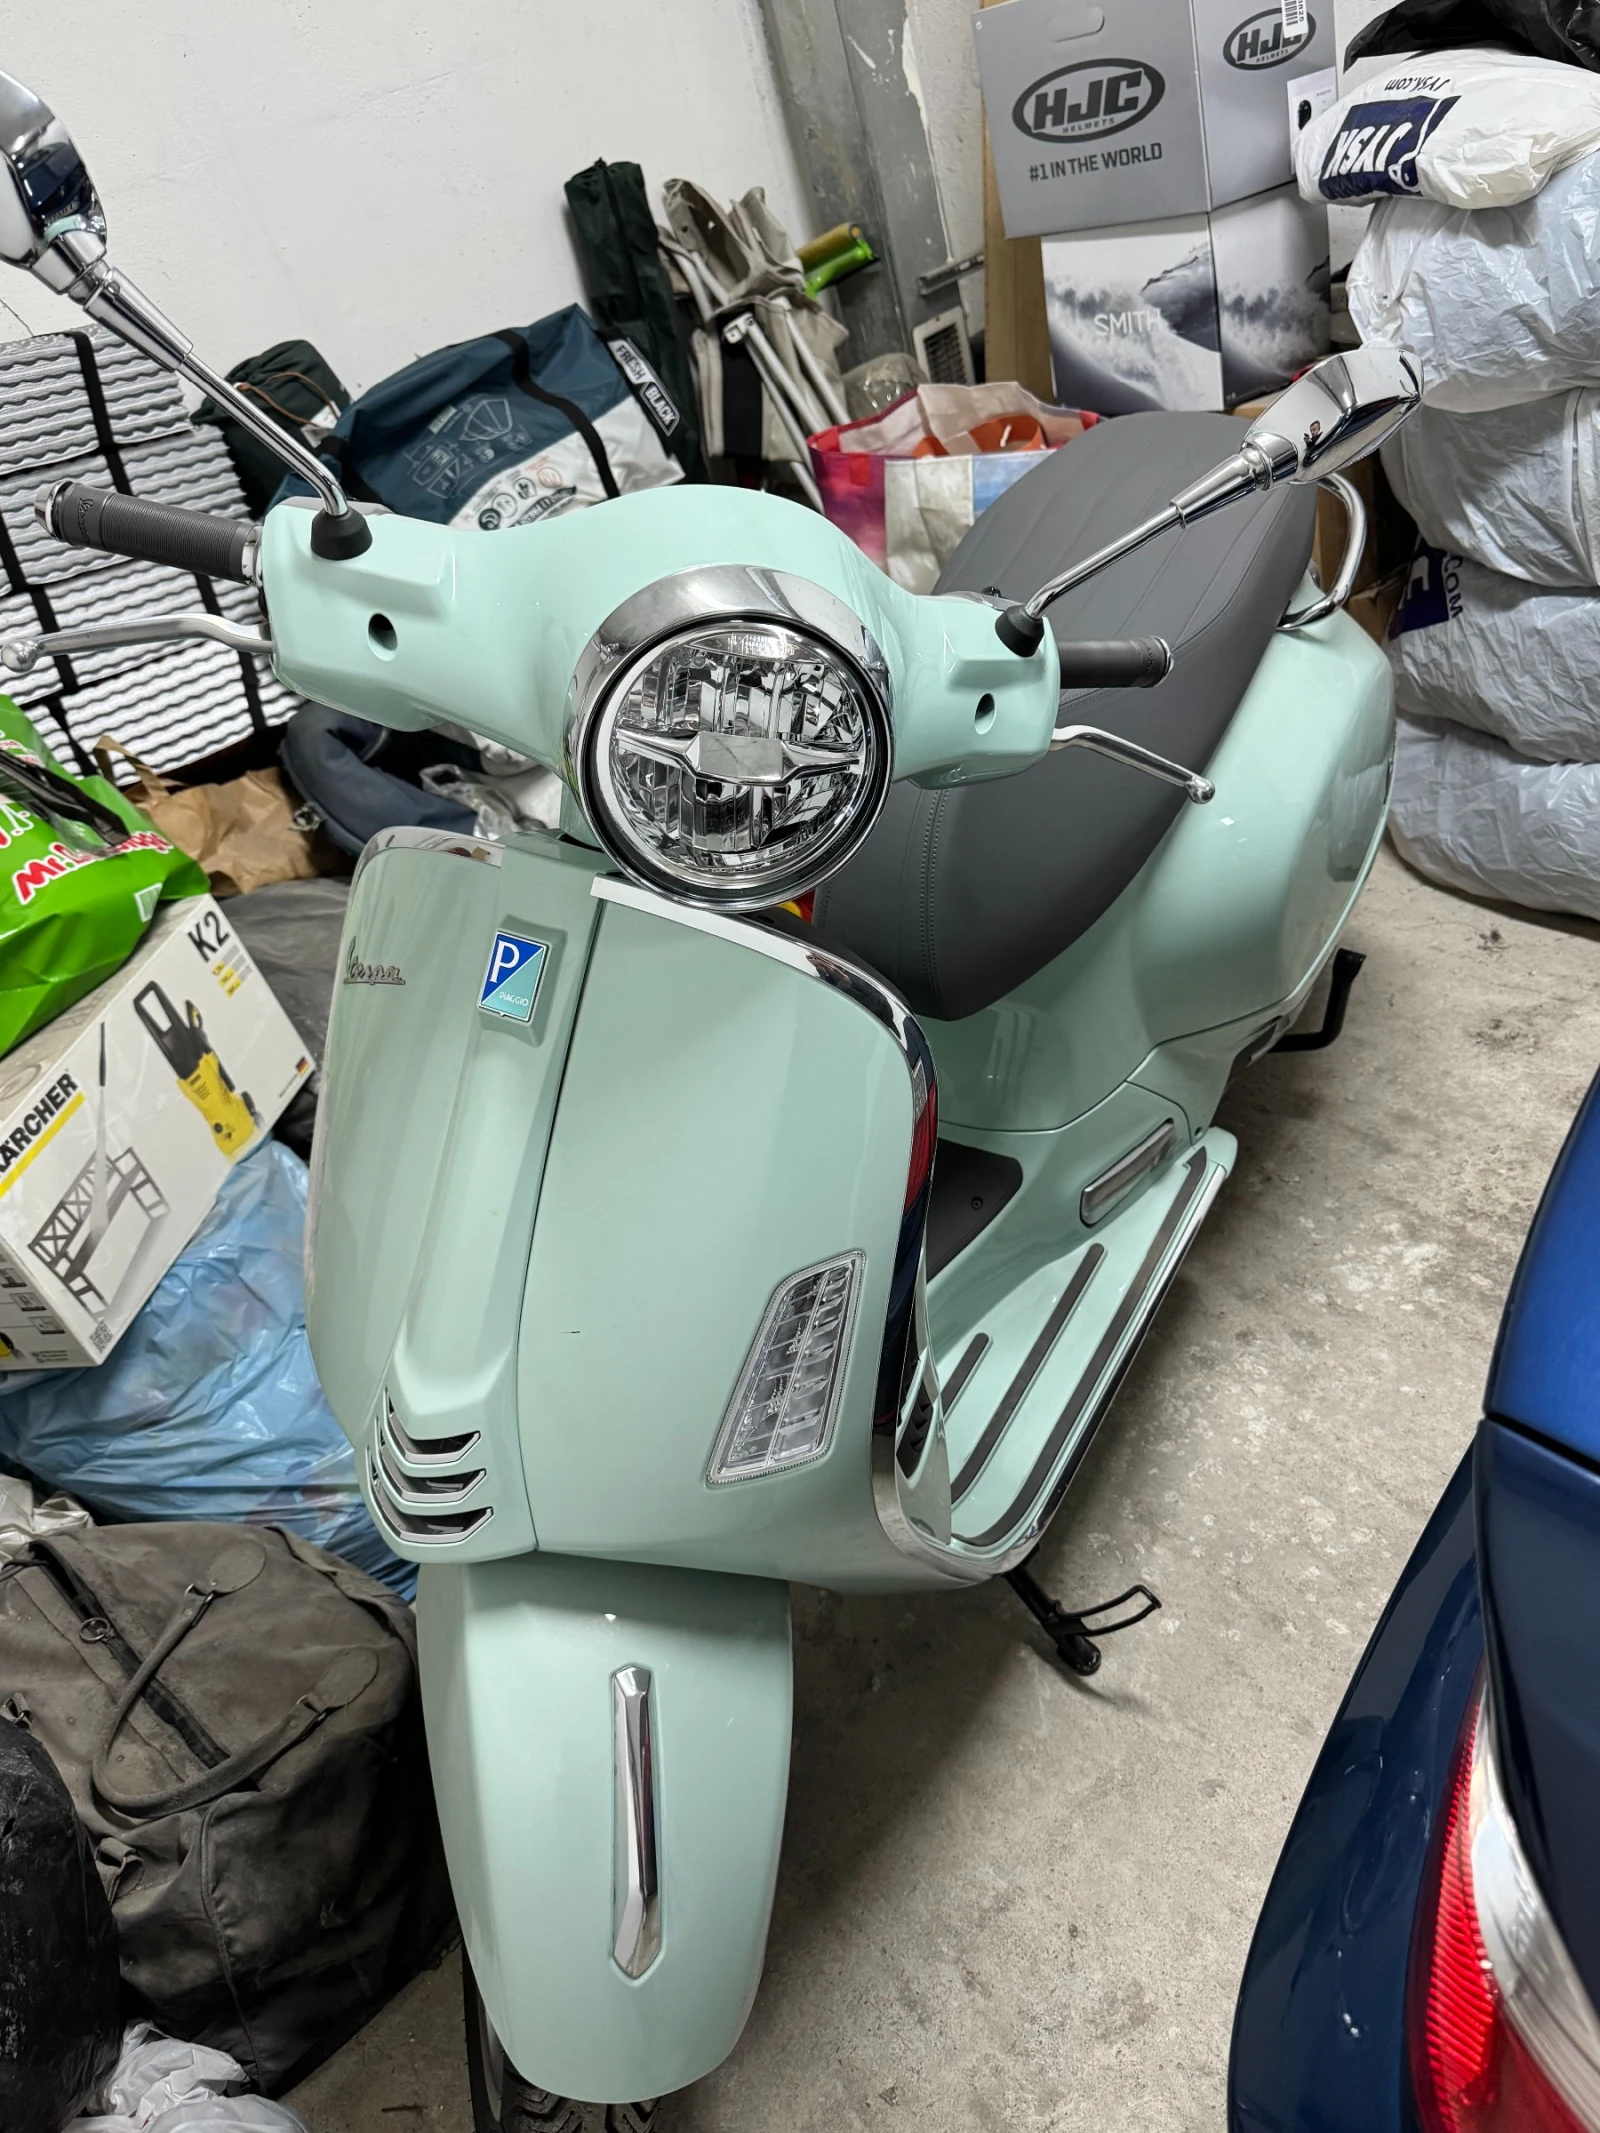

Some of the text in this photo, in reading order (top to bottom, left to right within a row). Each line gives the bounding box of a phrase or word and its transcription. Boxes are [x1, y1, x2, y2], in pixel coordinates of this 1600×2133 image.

[1033, 70, 1143, 131] HJC
[1062, 117, 1115, 134] HELMETS
[1029, 142, 1163, 182] #1 IN THE WORLD
[1322, 122, 1413, 180] JYSK
[1094, 308, 1161, 336] SMITH
[615, 344, 677, 426] FRESH BLACK
[187, 910, 231, 963] K2
[344, 935, 406, 985] Vespa
[489, 939, 520, 984] P
[499, 991, 529, 1007] PIAGGIO
